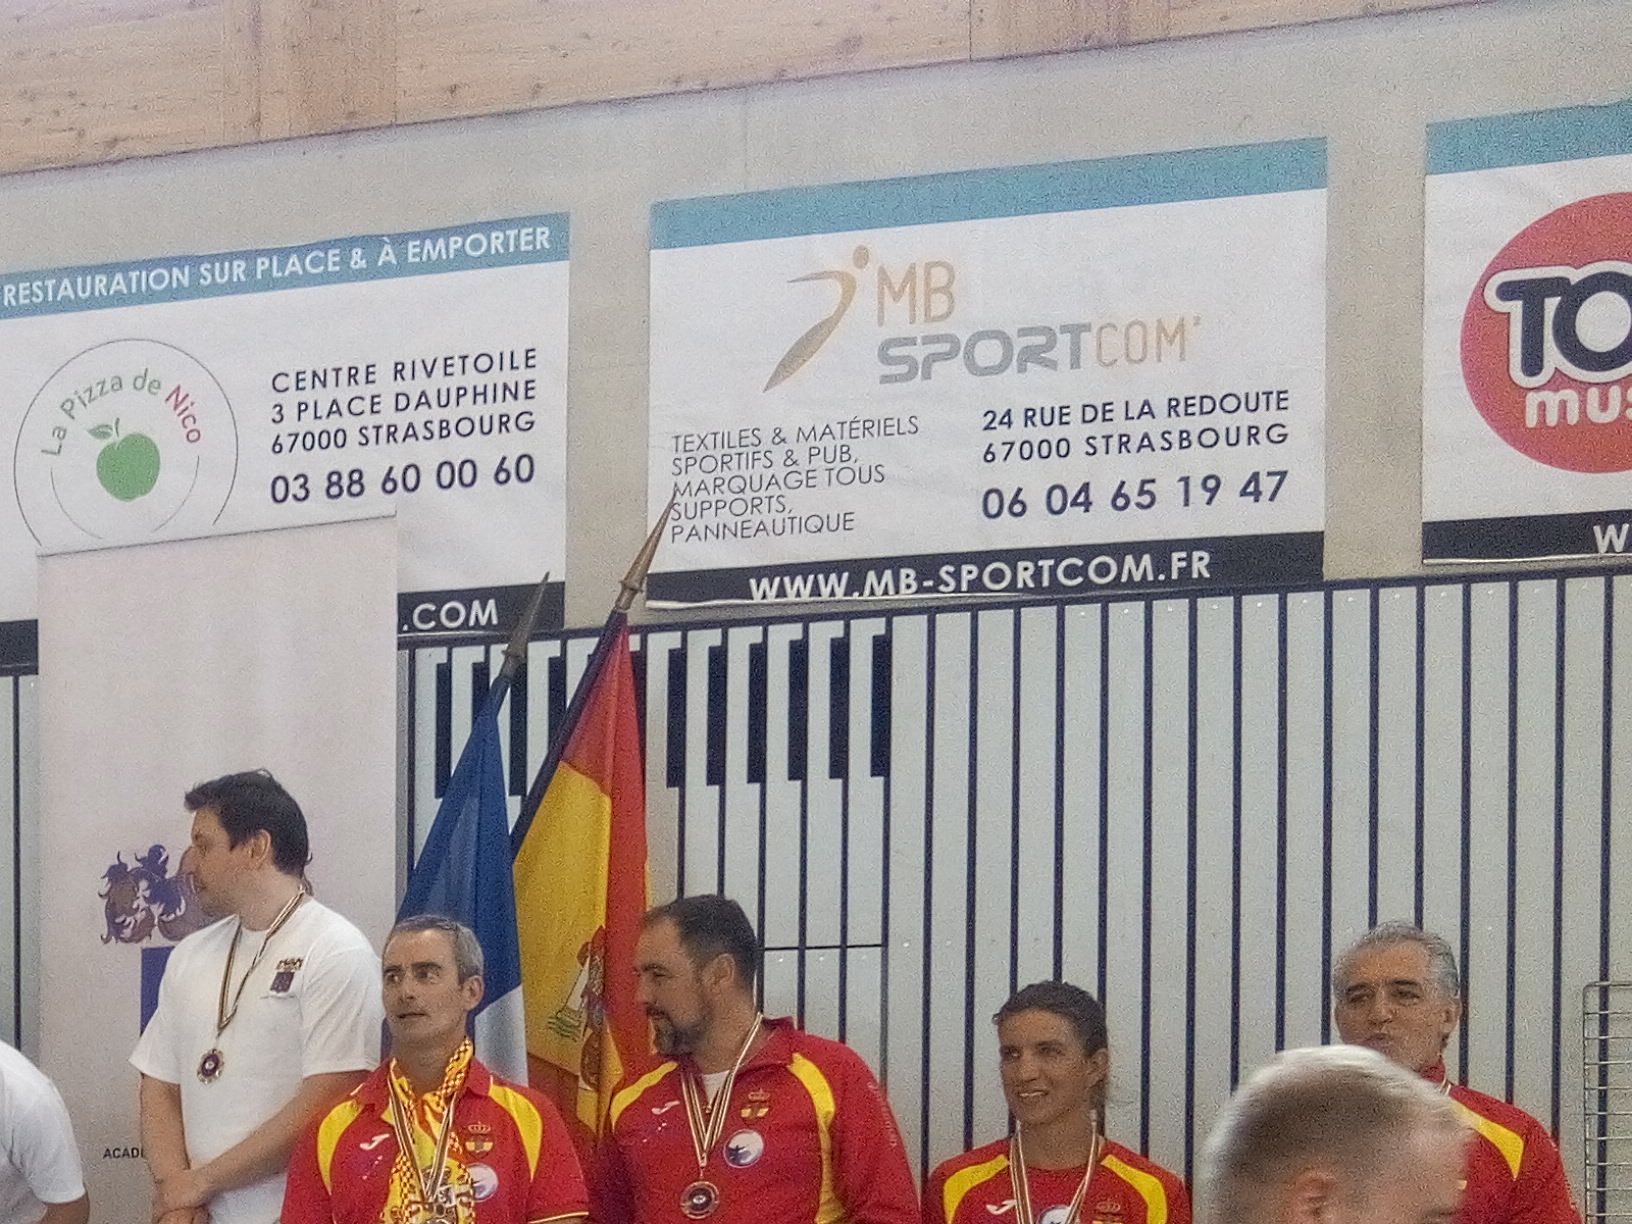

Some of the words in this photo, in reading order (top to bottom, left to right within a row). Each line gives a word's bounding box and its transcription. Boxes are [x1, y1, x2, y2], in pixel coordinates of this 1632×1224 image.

[2, 265, 191, 308] RESTAURATION
[199, 259, 247, 288] SUR
[256, 248, 341, 280] PLACE
[350, 247, 367, 269] &
[378, 236, 398, 267] À
[407, 225, 551, 264] EMPORTER
[876, 259, 956, 327] MB
[271, 364, 378, 393] CENTRE
[393, 348, 537, 382] RIVETOILE
[40, 425, 67, 458] La
[59, 374, 124, 422] Pizza
[132, 367, 164, 396] de
[164, 384, 202, 444] Nico
[271, 403, 285, 424] 3
[297, 394, 383, 422] PLACE
[395, 379, 536, 413] DAUPHINE
[982, 408, 1014, 431] 24
[1023, 405, 1071, 428] RUE
[1081, 401, 1115, 424] DE
[1124, 398, 1156, 421] LA
[1167, 389, 1290, 418] REDOUTE
[271, 428, 348, 455] 67000
[358, 411, 536, 447] STRASBOURG
[671, 427, 762, 453] TEXTILES
[771, 427, 787, 446] &
[796, 415, 920, 444] MATÉRIELS
[982, 437, 1071, 463] 67000
[1085, 422, 1289, 457] STRASBOURG
[270, 474, 311, 504] 03
[326, 469, 365, 500] 88
[381, 464, 421, 495] 60
[436, 459, 478, 490] 00
[494, 454, 535, 485] 60
[671, 450, 773, 477] SPORTIFS
[783, 449, 799, 467] &
[808, 444, 859, 466] PUB,
[673, 468, 817, 498] MARQUAGE
[825, 464, 886, 487] TOUS
[670, 494, 793, 522] SUPPORTS,
[981, 486, 1028, 520] 06
[1045, 481, 1094, 515] 04
[1110, 478, 1158, 512] 65
[1175, 473, 1222, 508] 19
[1238, 469, 1289, 504] 47
[671, 511, 856, 544] PANNEAUTIQUE
[748, 550, 1212, 603] WWW.MB-SPORTCOM.FR
